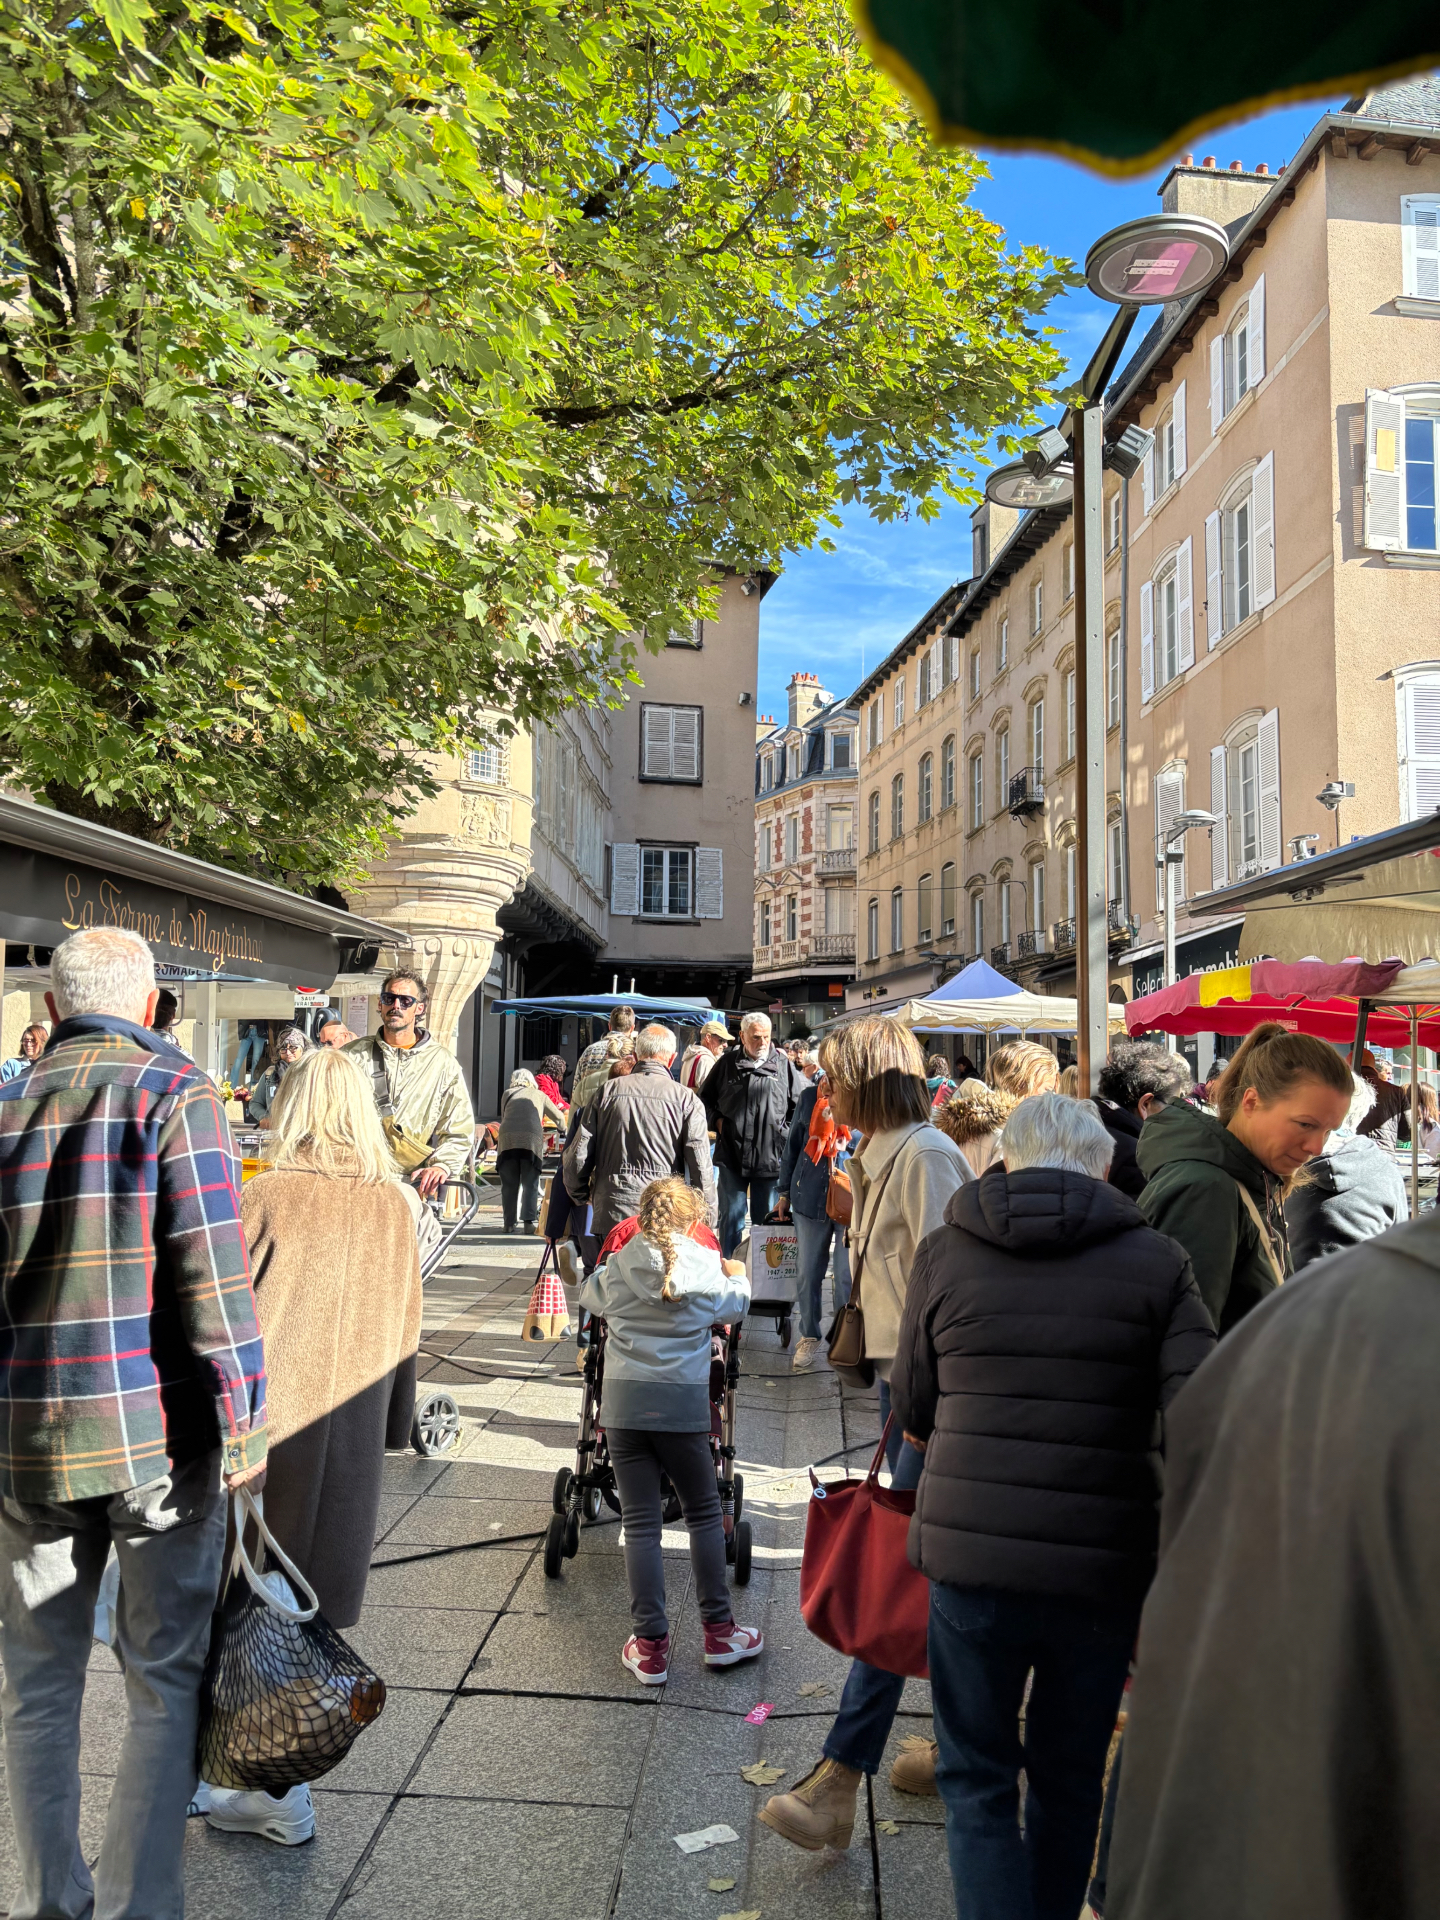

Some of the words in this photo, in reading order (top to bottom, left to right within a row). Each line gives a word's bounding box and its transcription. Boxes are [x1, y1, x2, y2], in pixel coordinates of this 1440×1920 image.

[61, 873, 98, 930] La
[99, 879, 165, 943] Ferme
[169, 908, 187, 948] de
